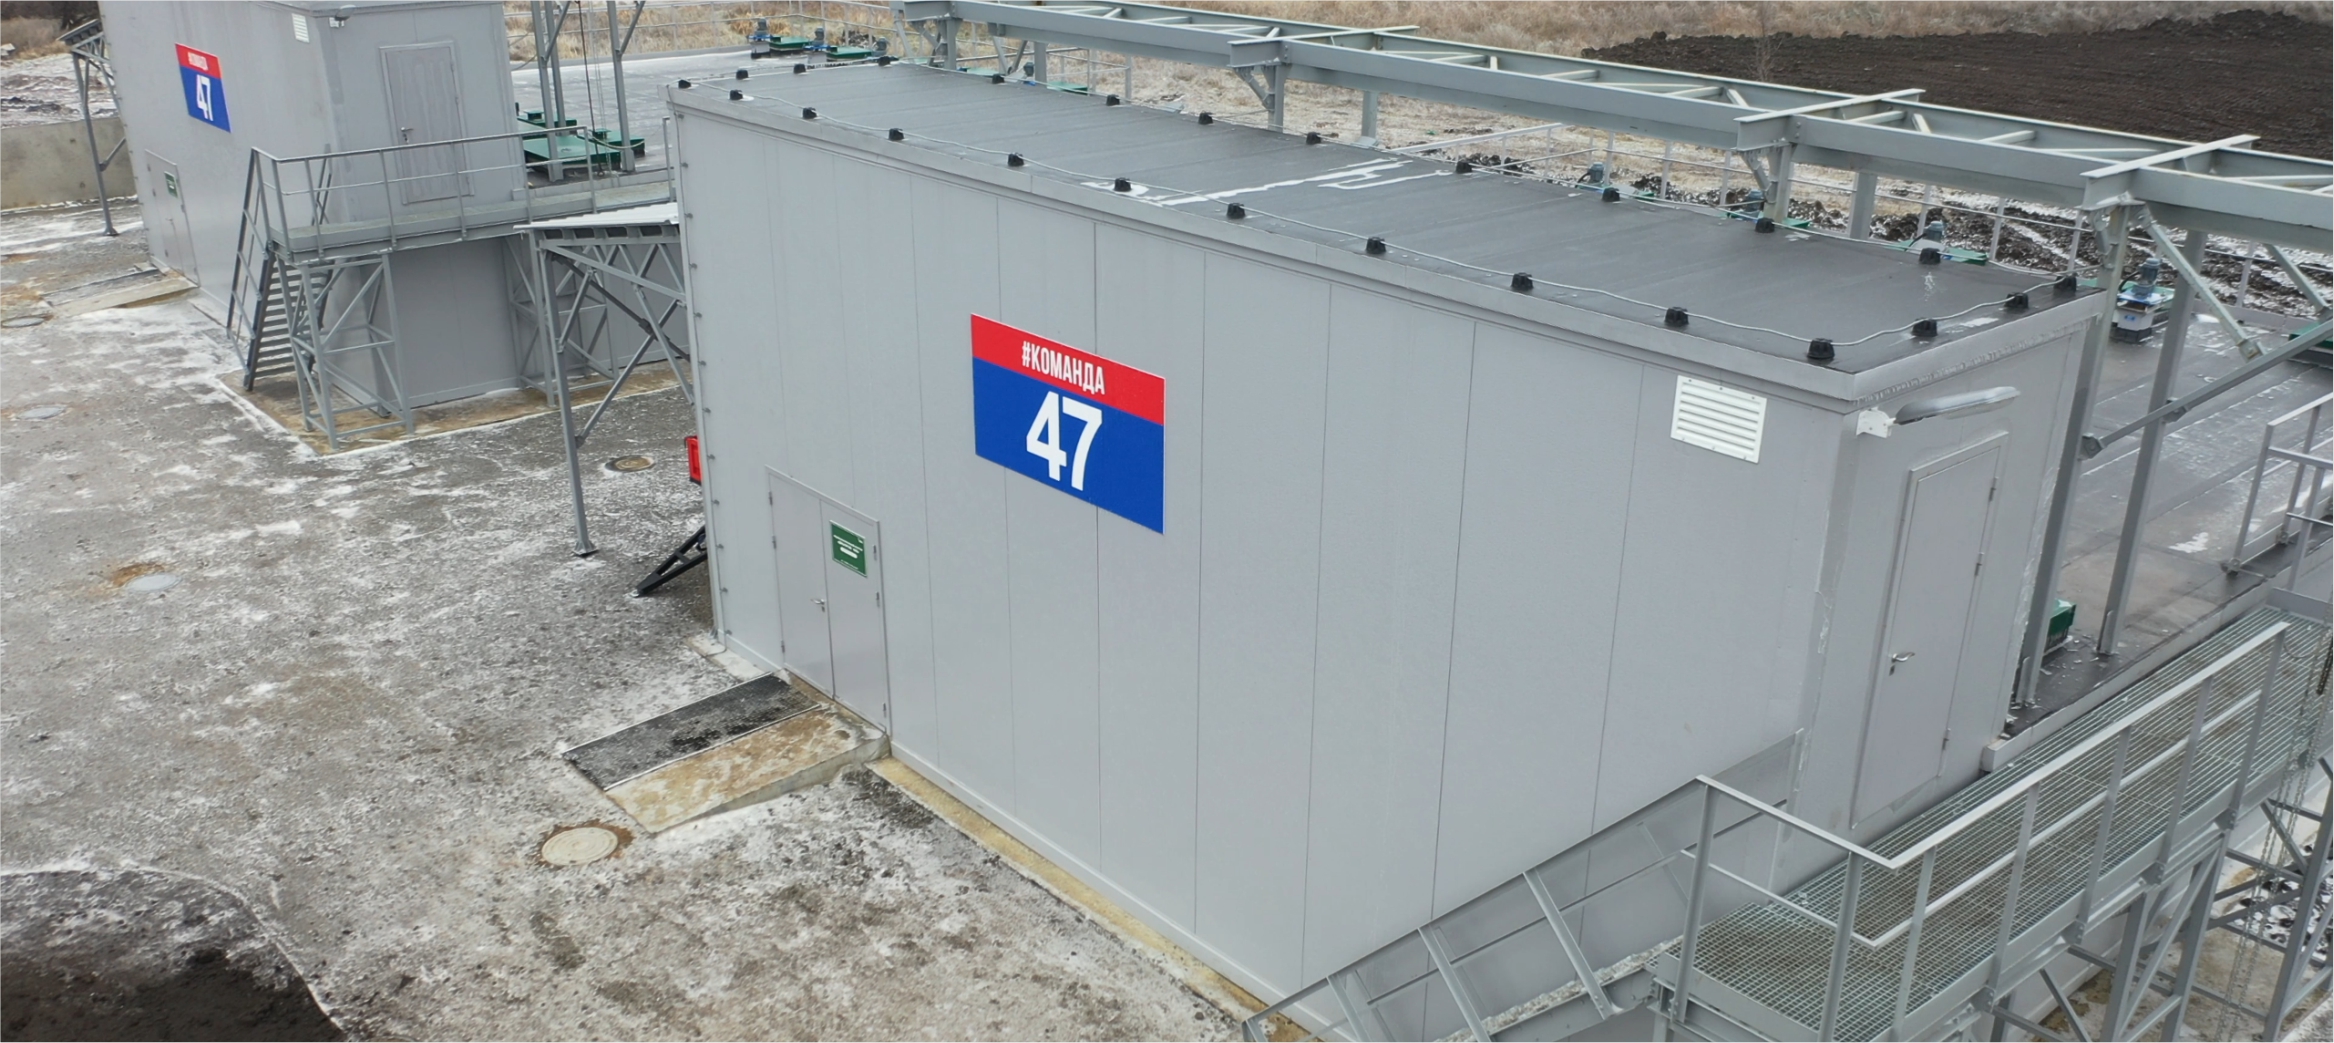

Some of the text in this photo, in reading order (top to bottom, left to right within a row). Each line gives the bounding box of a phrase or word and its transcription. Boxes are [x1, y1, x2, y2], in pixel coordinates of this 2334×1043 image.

[196, 74, 214, 122] 47
[1021, 340, 1105, 395] #КОМАНДА
[1026, 390, 1103, 491] 47
